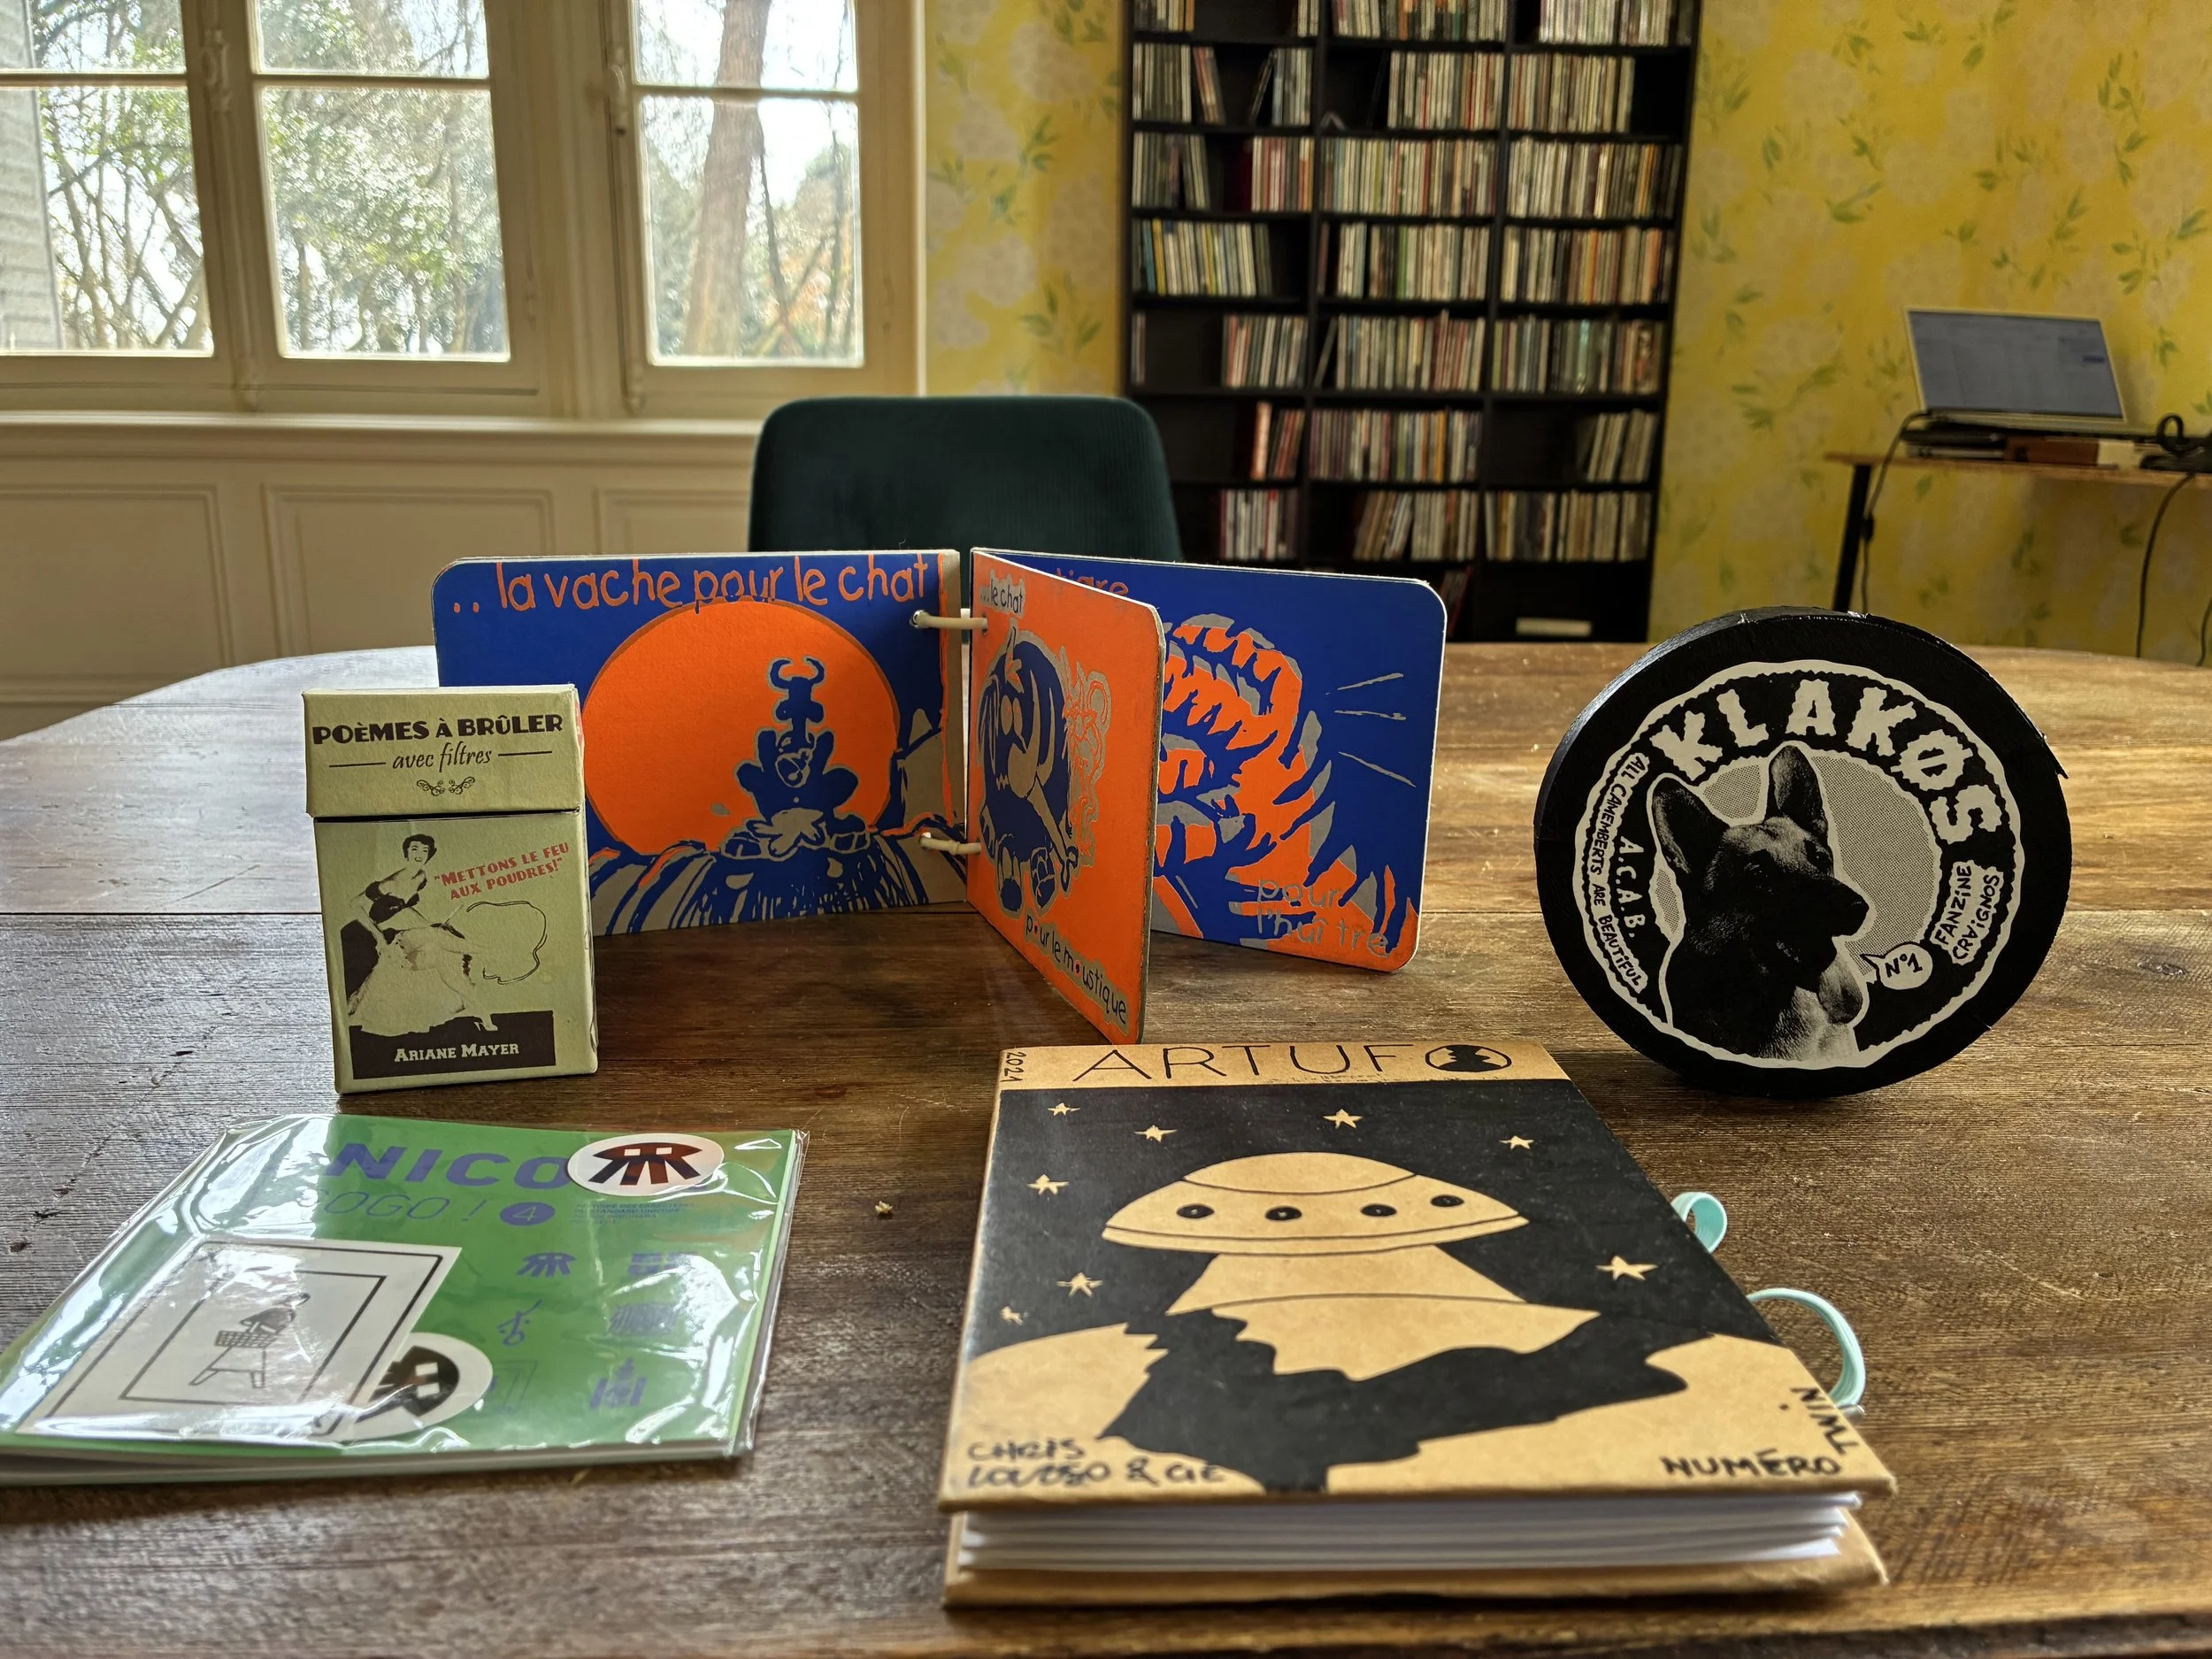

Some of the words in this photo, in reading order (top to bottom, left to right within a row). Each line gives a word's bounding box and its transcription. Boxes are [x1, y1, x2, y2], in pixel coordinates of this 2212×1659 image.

[495, 562, 535, 611] la
[544, 558, 682, 611] vache
[694, 566, 783, 614] pour
[794, 556, 828, 605] le
[838, 553, 928, 603] chat
[1056, 568, 1129, 595] tre
[1000, 585, 1024, 614] chat
[312, 720, 430, 745] POÈMES
[435, 718, 453, 739] À
[457, 714, 563, 737] BRÛLER
[392, 752, 434, 770] avec
[438, 741, 492, 772] filtres
[1621, 757, 1645, 780] ALL
[1590, 783, 1626, 875] CAMEMBERTS
[521, 850, 538, 864] LE
[542, 842, 569, 858] FEU
[450, 882, 481, 900] AUX
[1257, 879, 1341, 907] pour
[1592, 884, 1606, 907] ARE
[1052, 931, 1061, 963] le
[1001, 1051, 1026, 1082] 2021
[319, 1191, 450, 1223] OGO
[1659, 1448, 1841, 1478] NUMÉRO
